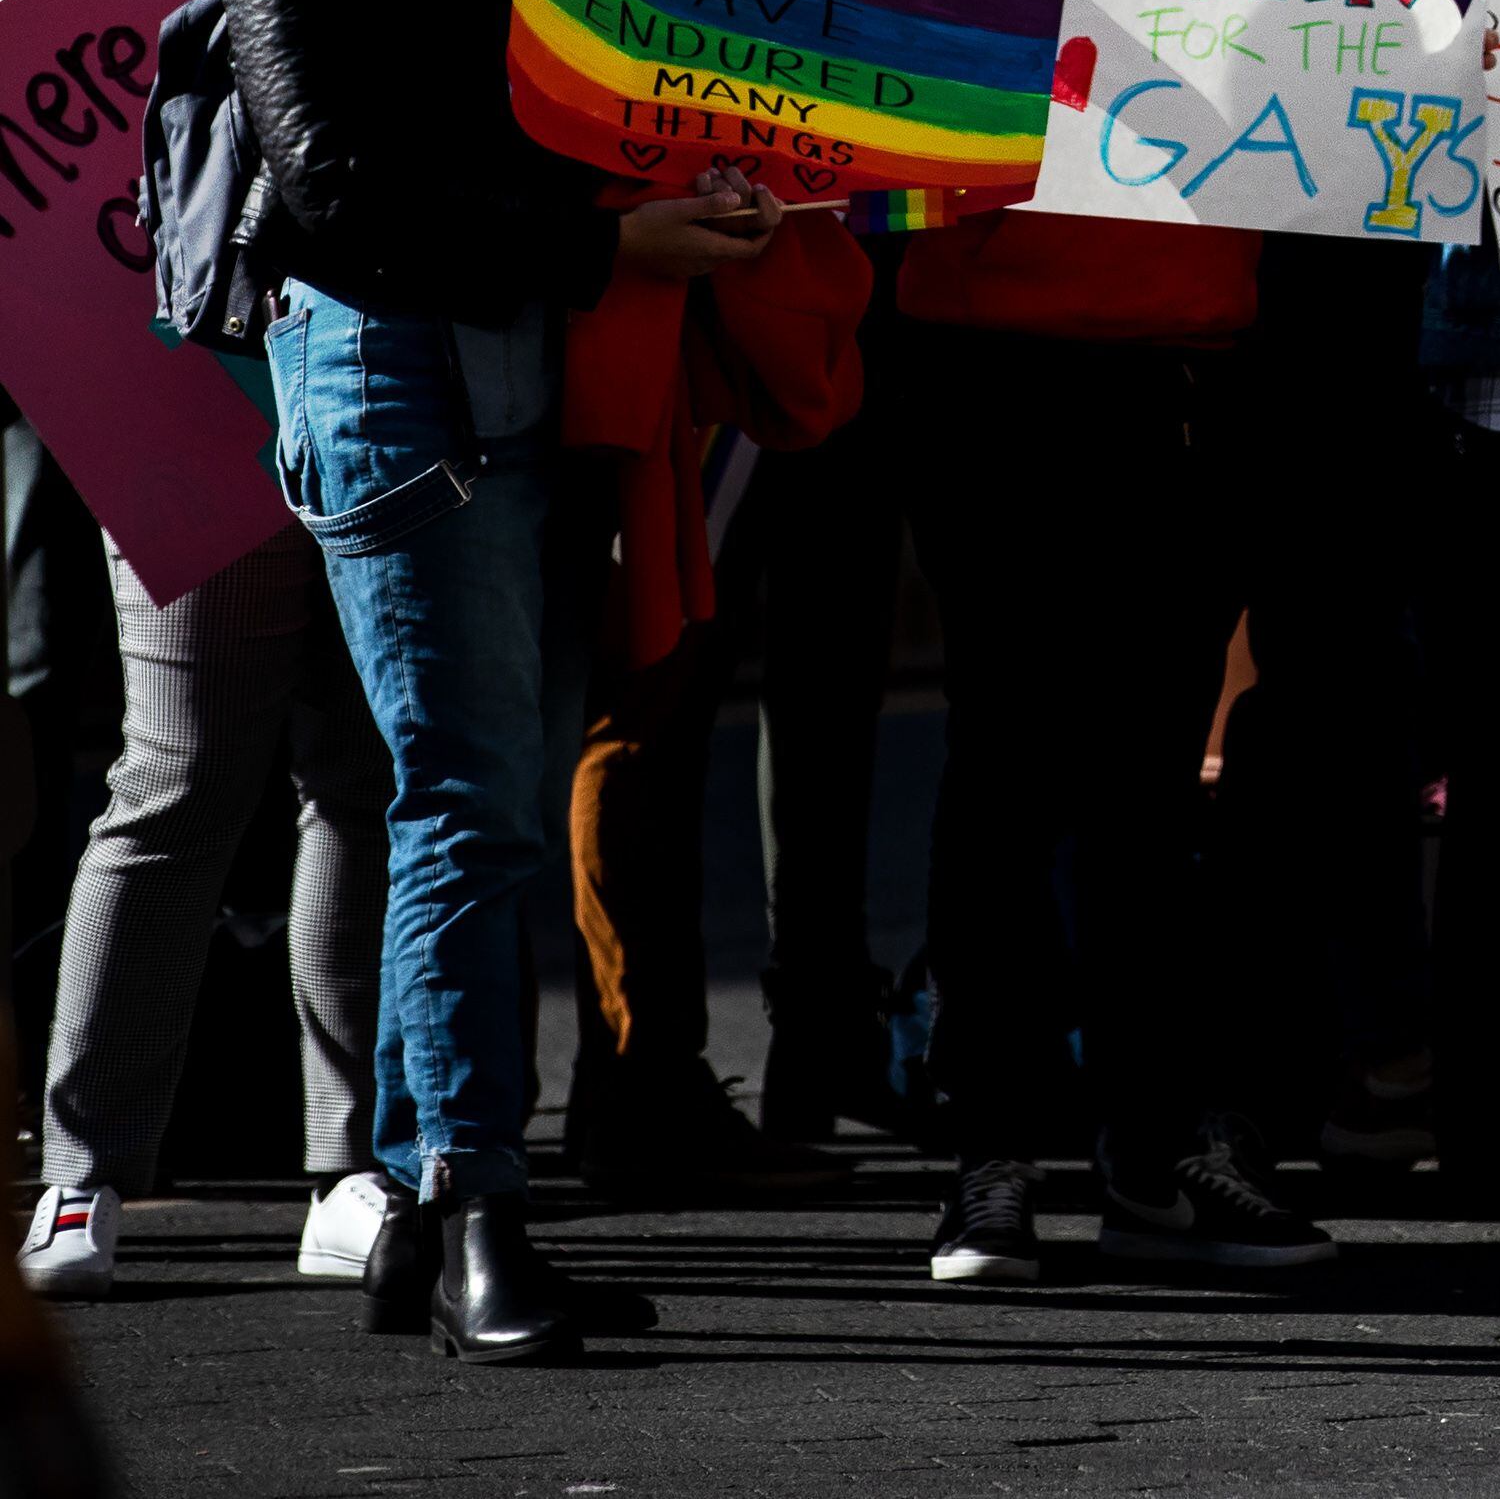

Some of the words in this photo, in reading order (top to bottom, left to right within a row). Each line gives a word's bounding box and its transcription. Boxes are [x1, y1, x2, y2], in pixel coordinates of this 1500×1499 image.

[1138, 7, 1267, 64] FOR
[1288, 20, 1403, 76] THE
[653, 68, 818, 124] MANY
[0, 26, 153, 240] here
[614, 97, 855, 167] THINGS
[1100, 79, 1485, 239] GAYS
